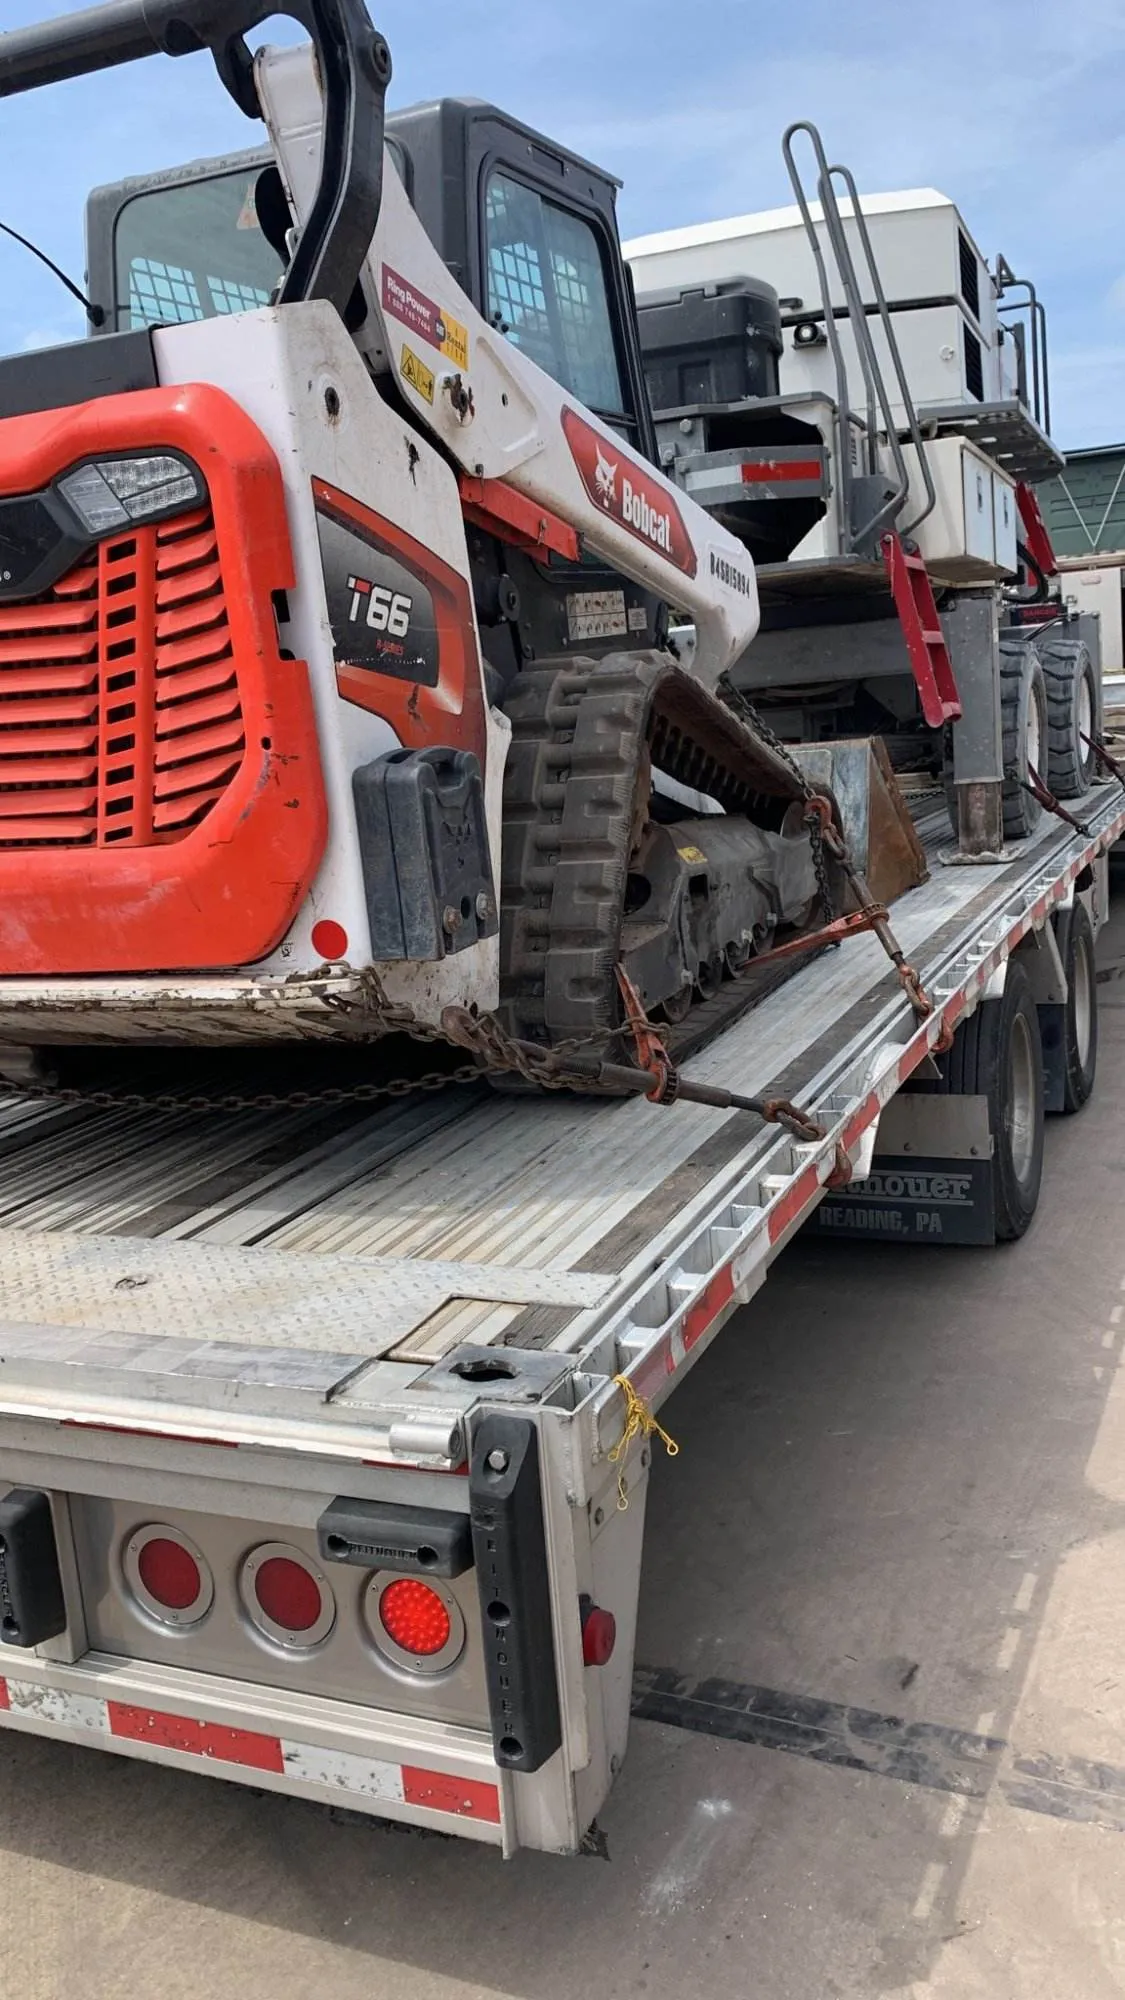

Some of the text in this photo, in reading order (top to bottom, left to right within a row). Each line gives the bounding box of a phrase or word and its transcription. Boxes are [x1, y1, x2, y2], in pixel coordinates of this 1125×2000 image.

[387, 275, 431, 318] Ring Power
[622, 478, 670, 552] Bobcat
[347, 576, 412, 637] T66
[916, 1212, 942, 1232] PA
